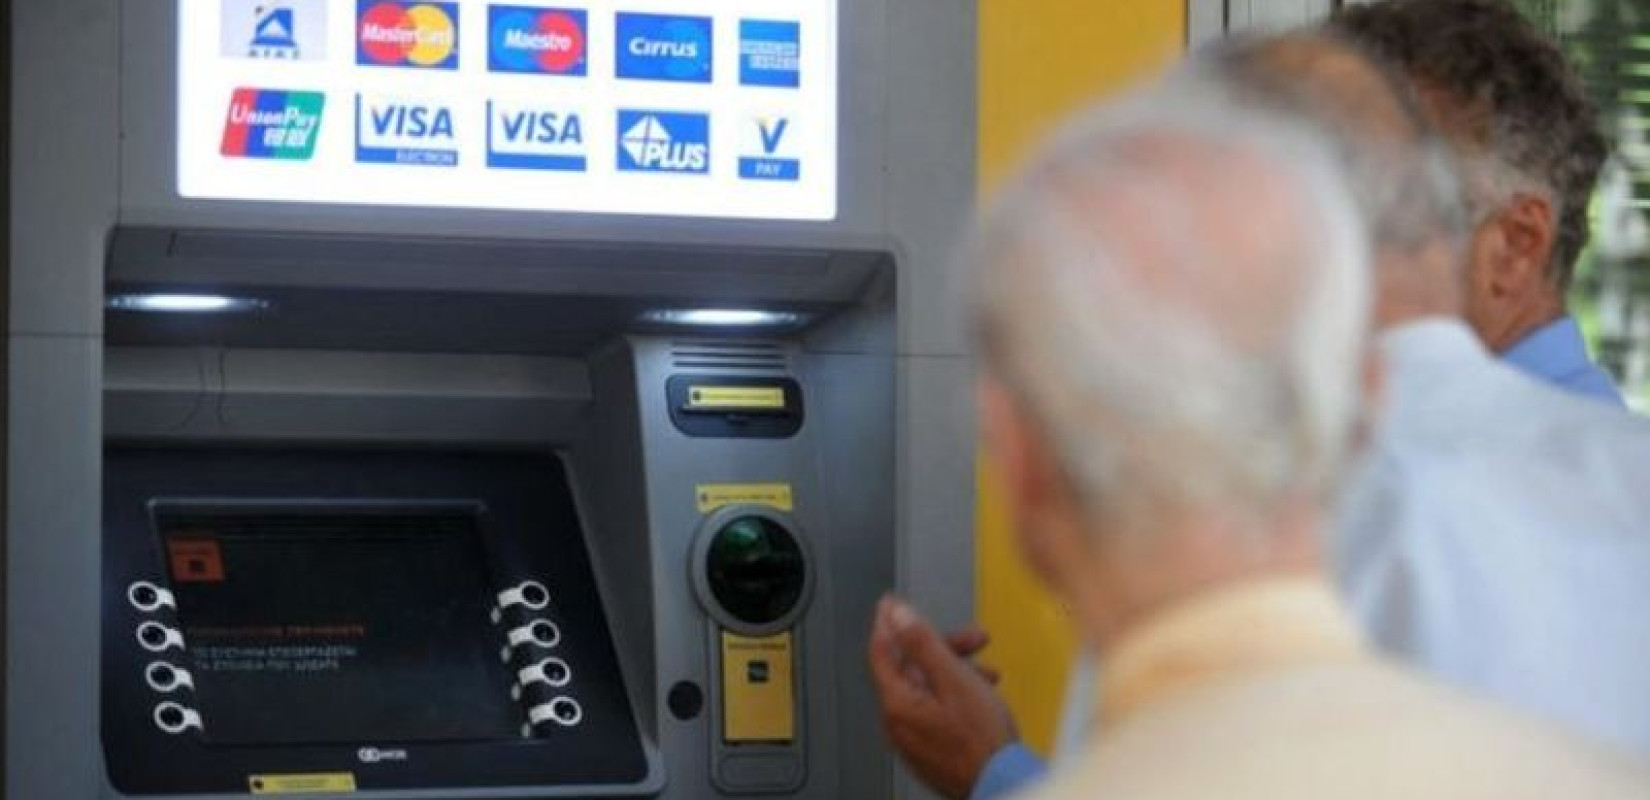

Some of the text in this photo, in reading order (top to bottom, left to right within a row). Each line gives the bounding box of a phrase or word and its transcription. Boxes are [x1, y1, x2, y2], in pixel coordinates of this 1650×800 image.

[362, 22, 455, 45] MasterCard
[504, 30, 573, 53] Maestro
[628, 38, 698, 58] Cirrus
[231, 102, 318, 131] UnionPay
[370, 105, 455, 138] VISA
[501, 111, 582, 145] VISA
[755, 117, 789, 154] V
[648, 142, 707, 170] PLUS
[754, 162, 782, 176] PAY
